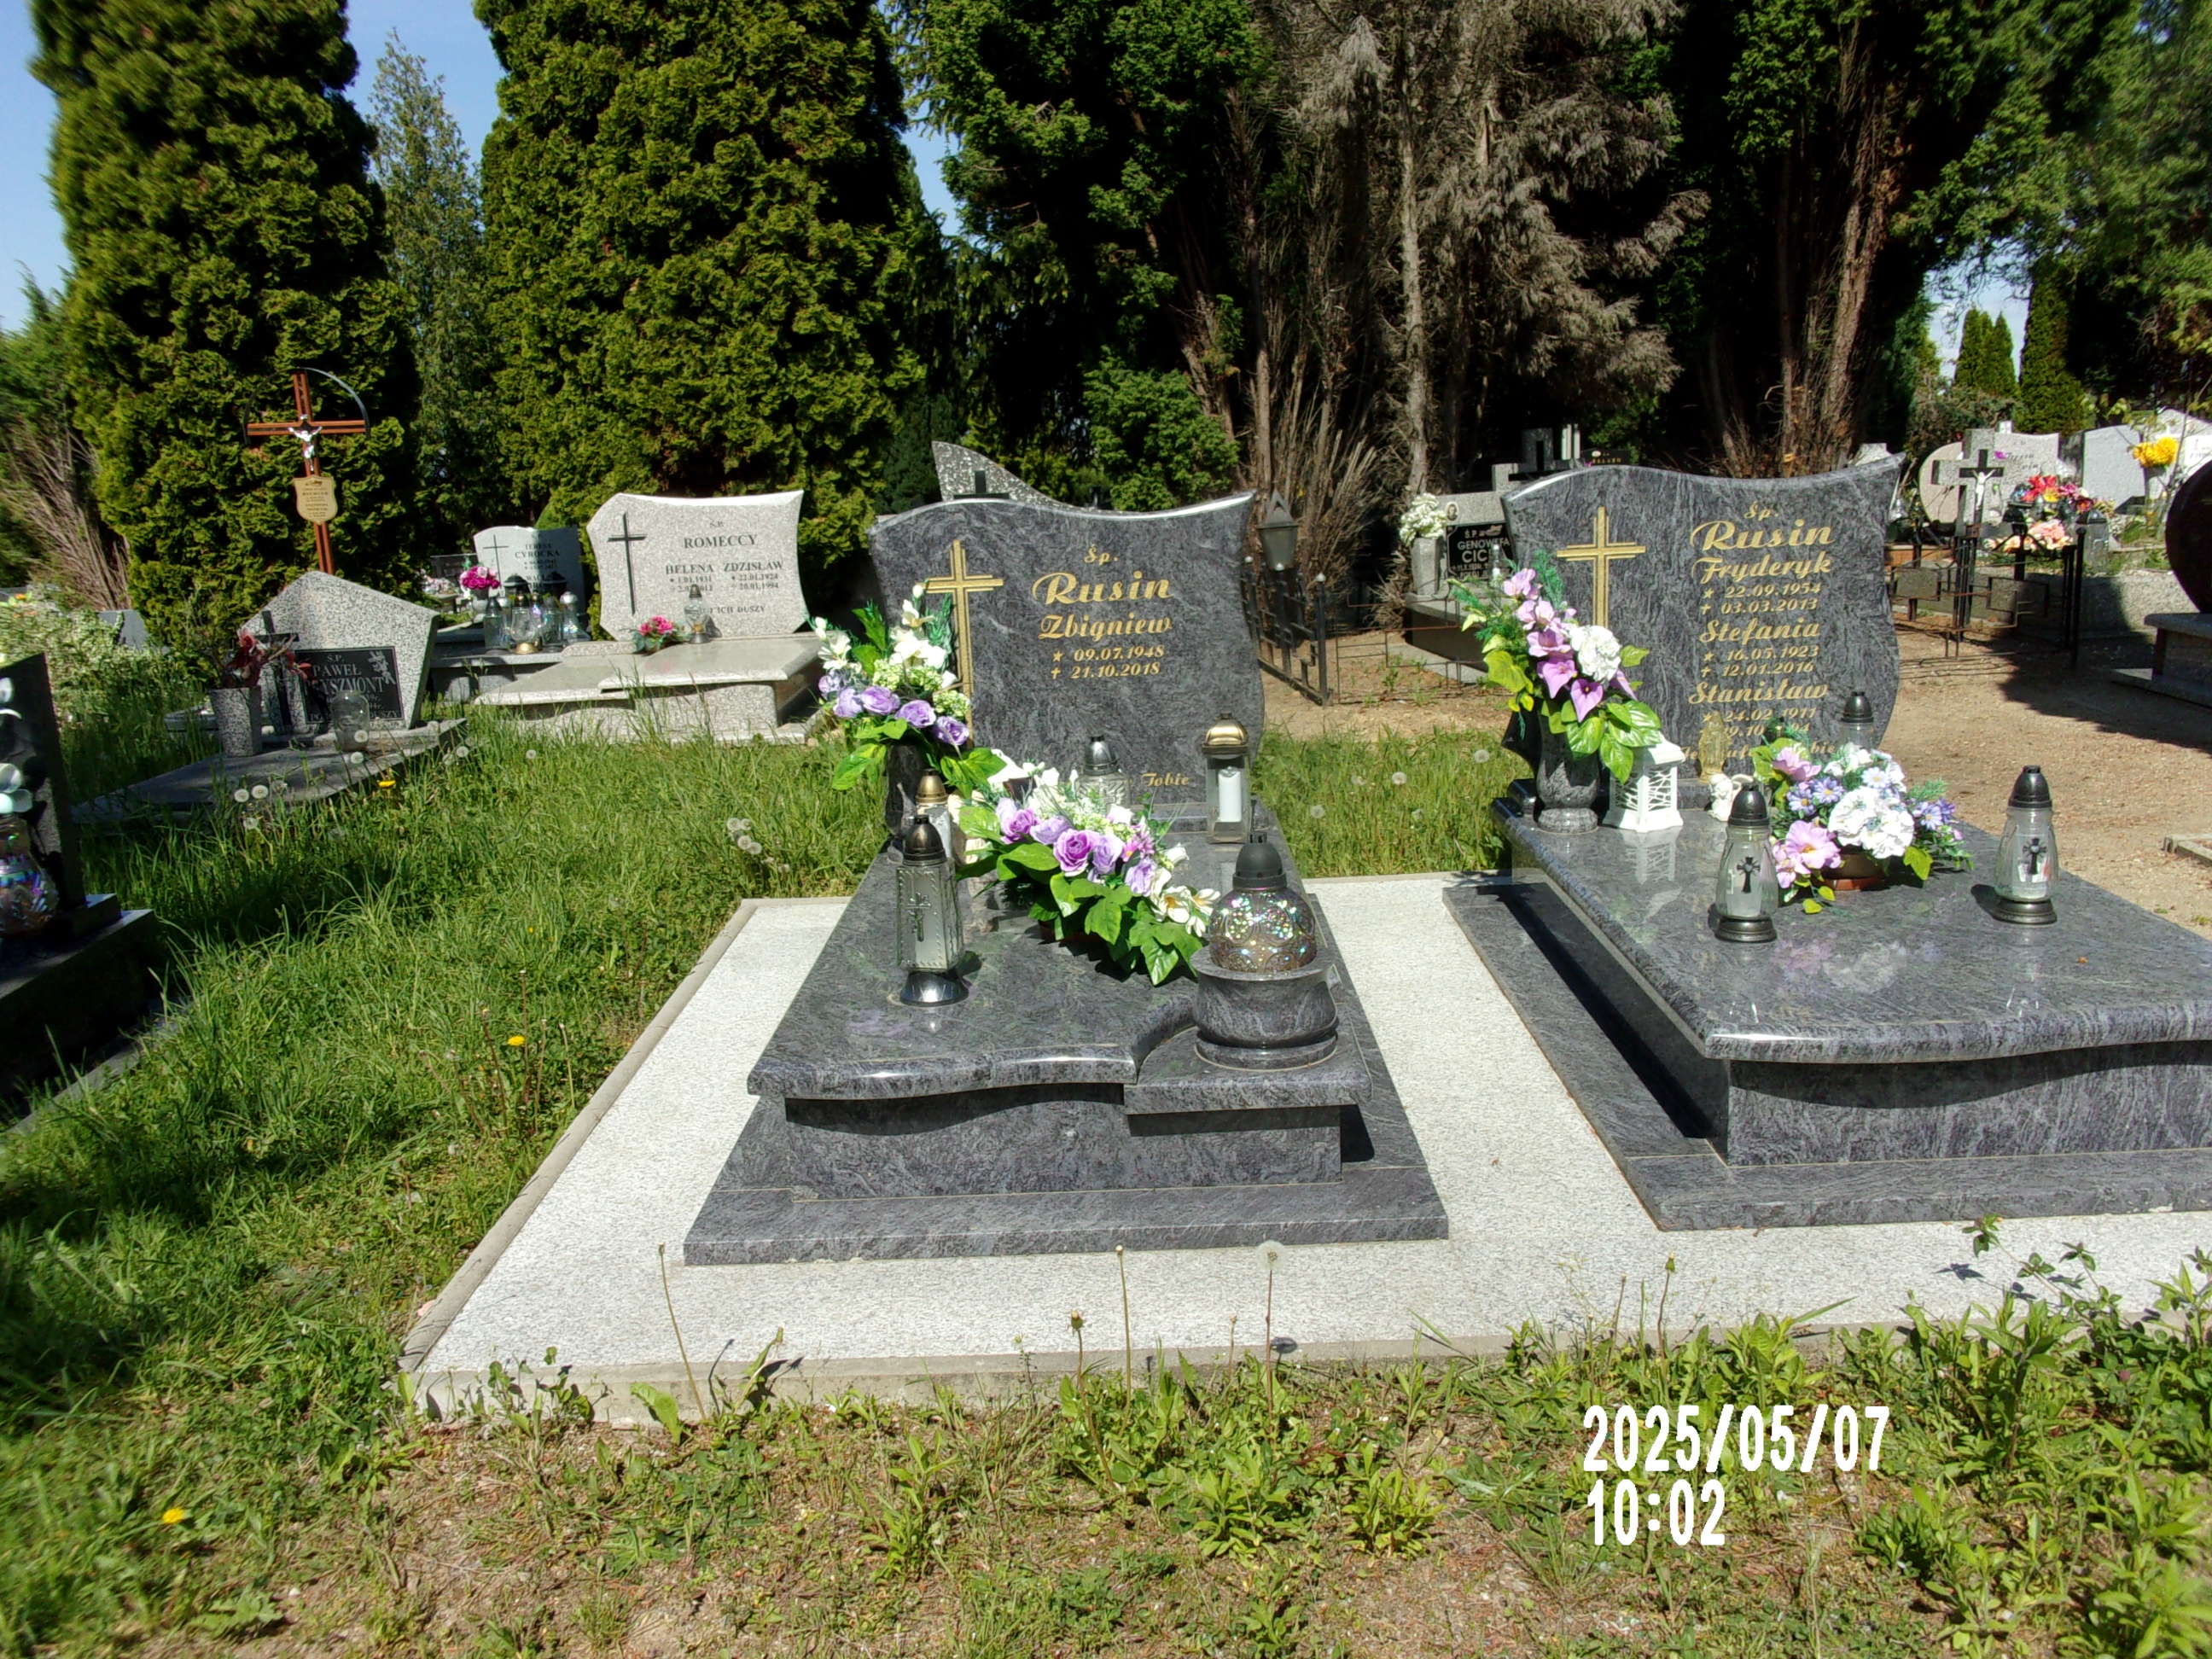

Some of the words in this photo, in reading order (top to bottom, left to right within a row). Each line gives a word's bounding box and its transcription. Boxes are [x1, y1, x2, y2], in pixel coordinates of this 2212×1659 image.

[683, 534, 758, 549] ROMECCY
[1690, 519, 1836, 551] Rusin
[665, 564, 714, 574] HELENA
[1691, 550, 1831, 584] Fryderyk
[1031, 570, 1175, 605] Rusin
[1725, 582, 1822, 598] 22.09.1954
[1720, 598, 1819, 614] 03.03.2013
[1037, 612, 1173, 642] Zbigniew
[1699, 617, 1821, 645] Stefania
[1073, 645, 1166, 662] 09.07.1948
[1726, 644, 1820, 661] 16.05.1923
[1071, 661, 1161, 679] 21.10.2018
[1721, 661, 1815, 677] 12.01.2016
[1142, 771, 1190, 788] Tobie
